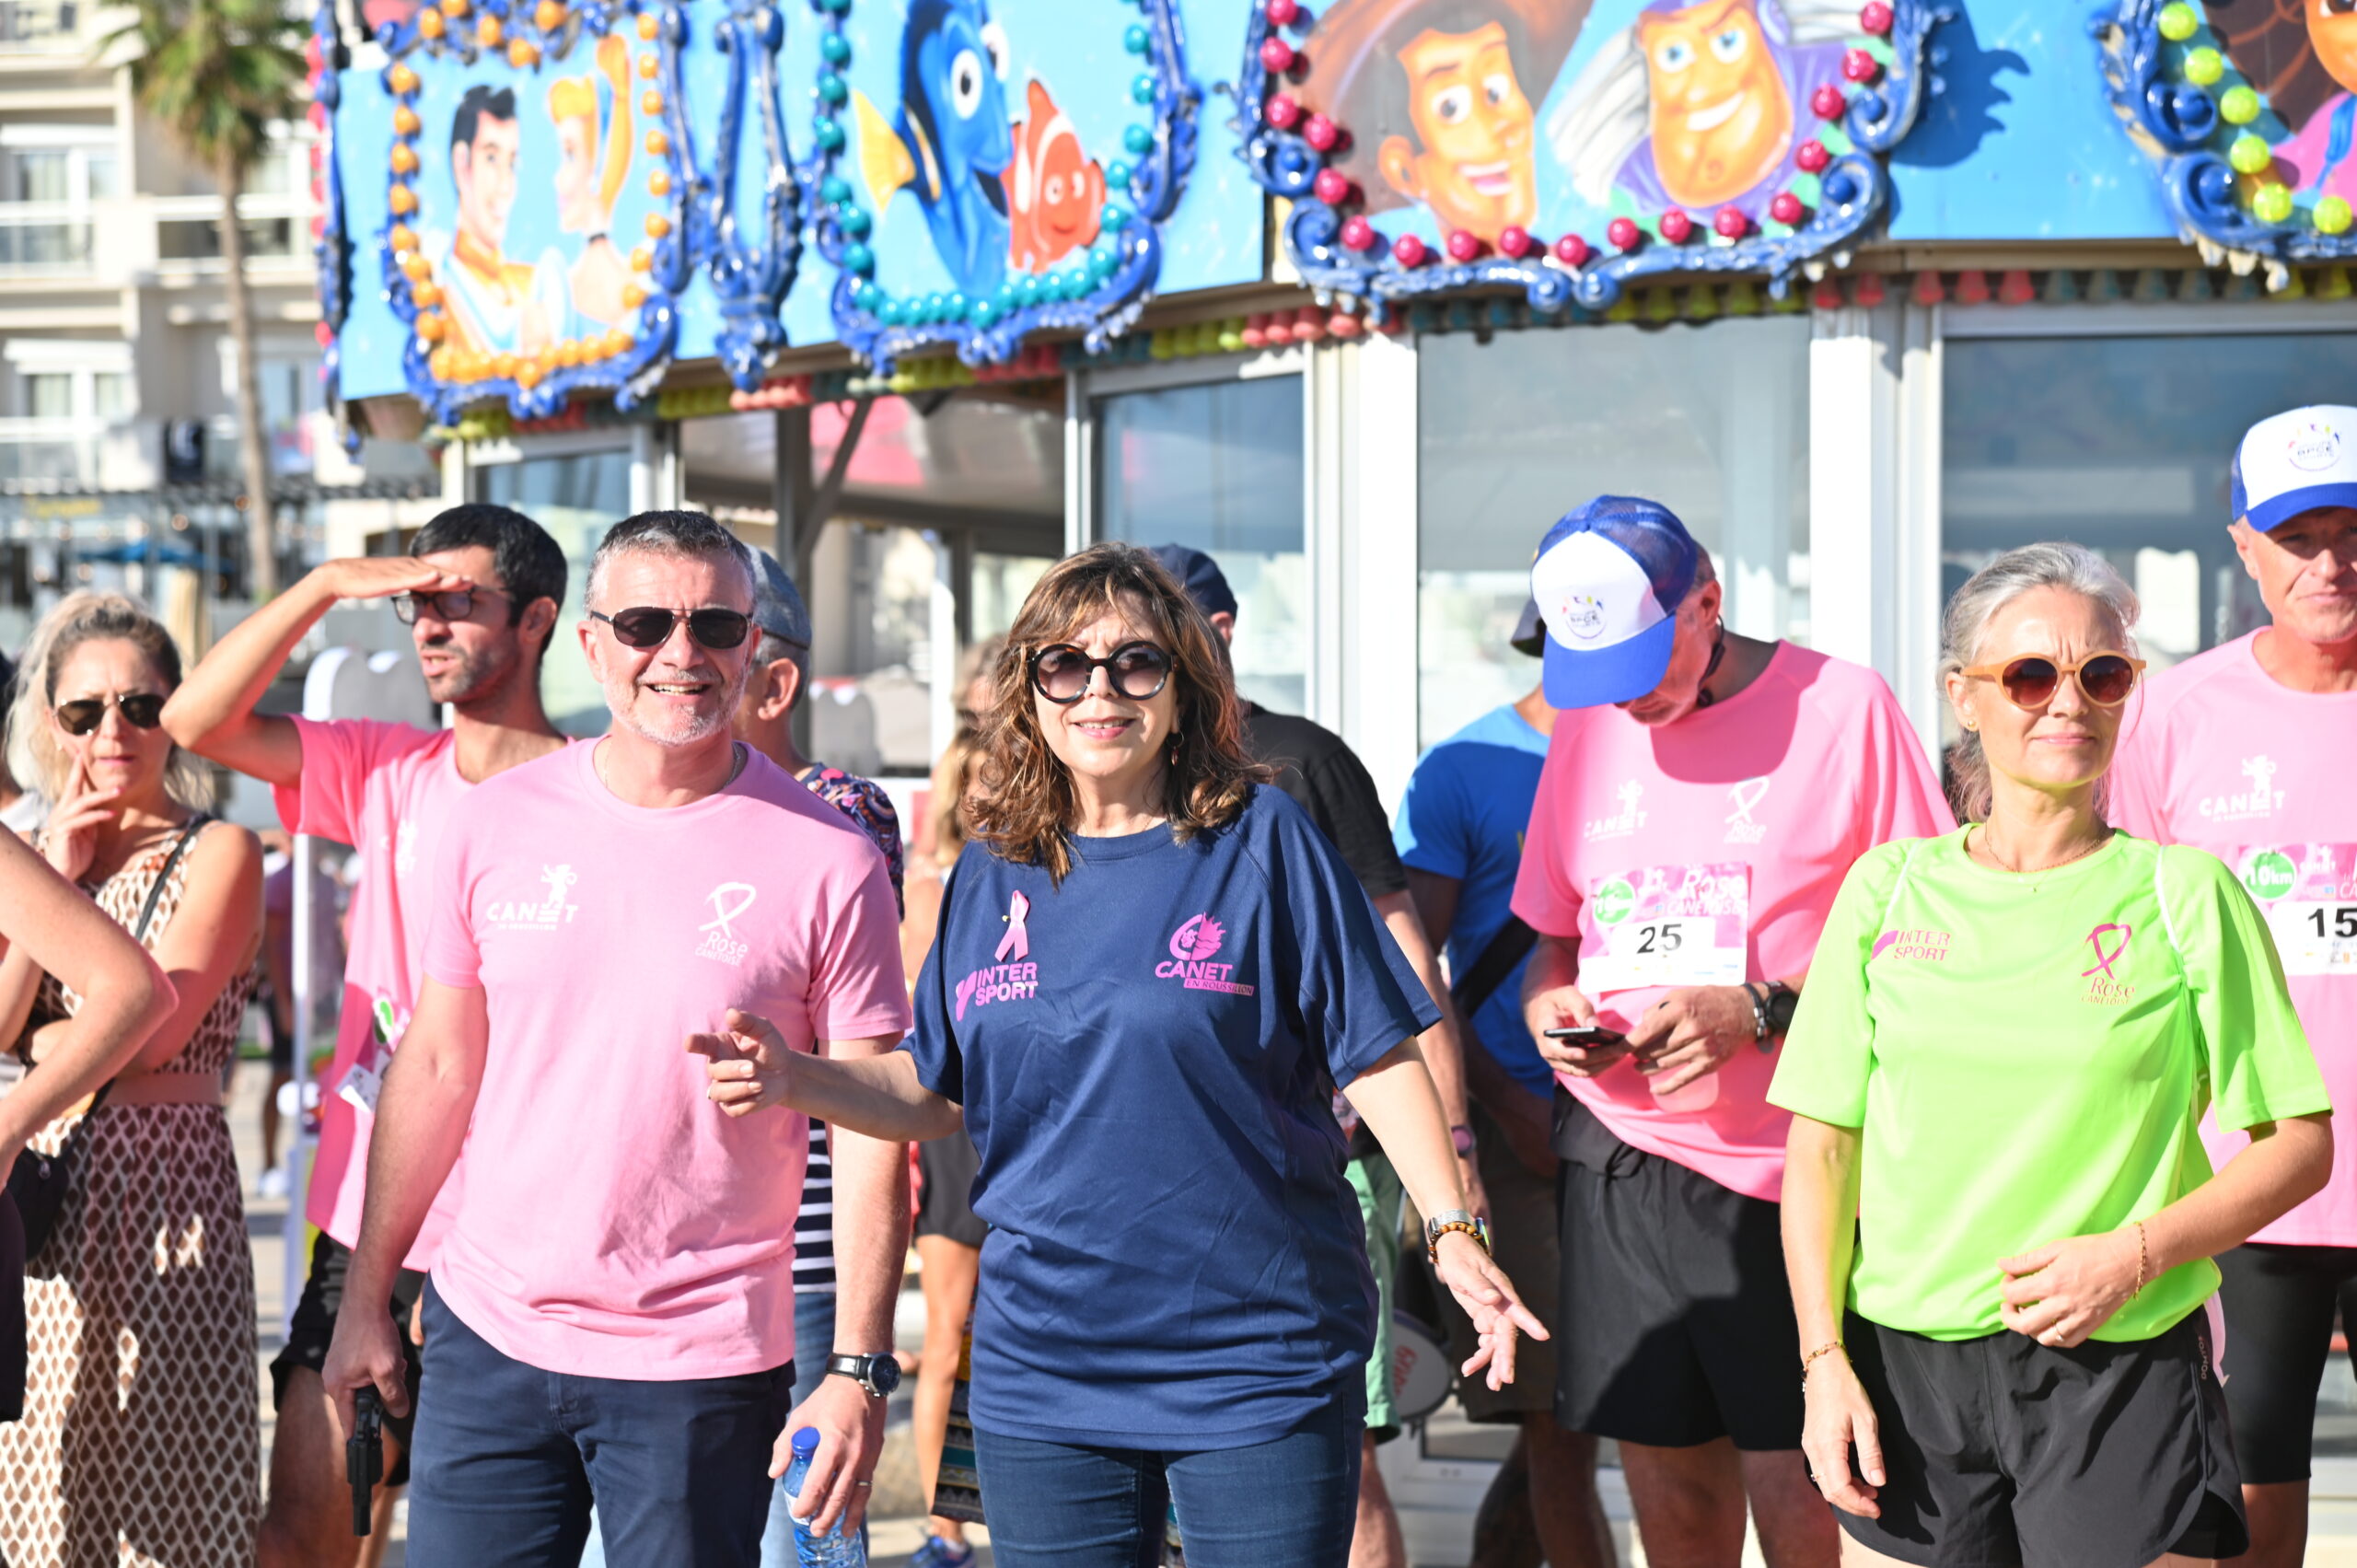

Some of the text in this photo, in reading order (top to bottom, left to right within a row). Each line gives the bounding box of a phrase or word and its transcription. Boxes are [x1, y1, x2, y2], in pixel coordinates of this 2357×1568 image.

[2199, 790, 2286, 818] CANET
[486, 901, 578, 923] CANET
[705, 931, 748, 958] Rose
[1636, 923, 1682, 954] 25
[1898, 929, 1950, 947] INTER
[1894, 946, 1948, 961] SPORT
[977, 961, 1038, 987] INTER
[1155, 960, 1233, 981] CANET
[975, 981, 1039, 1006] SPORT
[1186, 978, 1253, 995] EN ROUSSILLON
[2091, 976, 2135, 999] Rose
